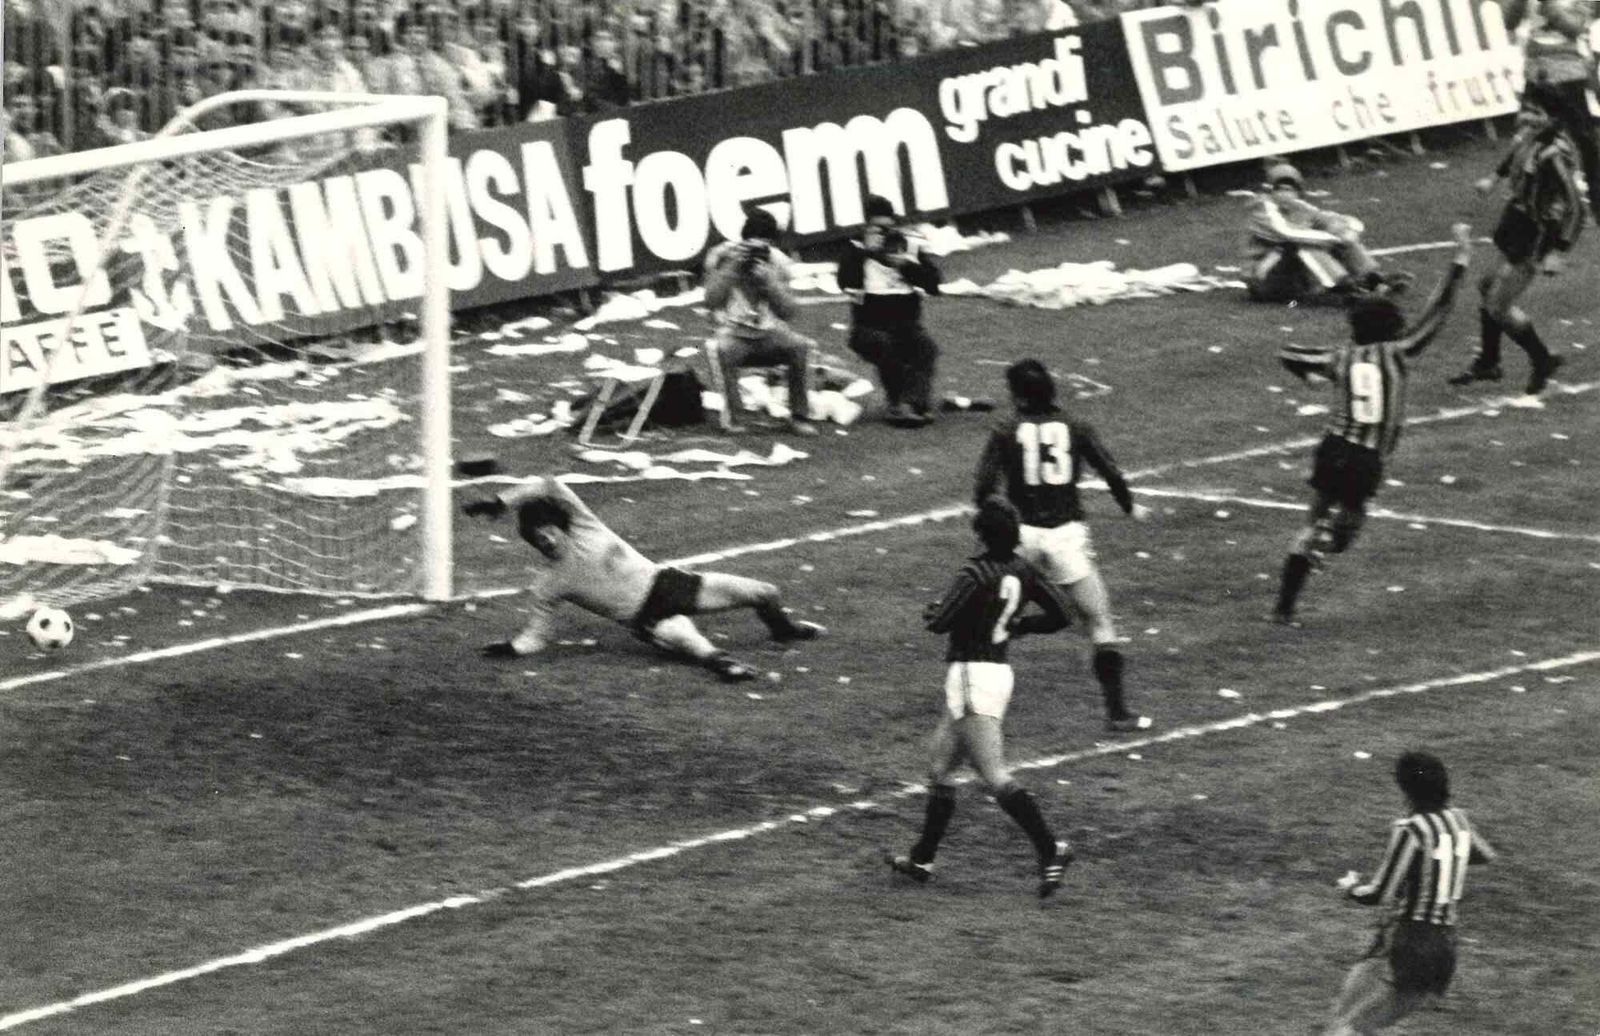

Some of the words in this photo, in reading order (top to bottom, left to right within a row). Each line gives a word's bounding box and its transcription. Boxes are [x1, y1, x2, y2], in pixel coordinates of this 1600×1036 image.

[939, 35, 1088, 143] grandi
[1168, 108, 1298, 159] Salute
[1332, 86, 1397, 130] che
[995, 109, 1154, 191] cucine
[583, 107, 949, 273] foem
[177, 140, 590, 331] KAMBUSA
[1351, 362, 1383, 424] 9
[1016, 422, 1073, 486] 13
[1434, 830, 1472, 904] 11
